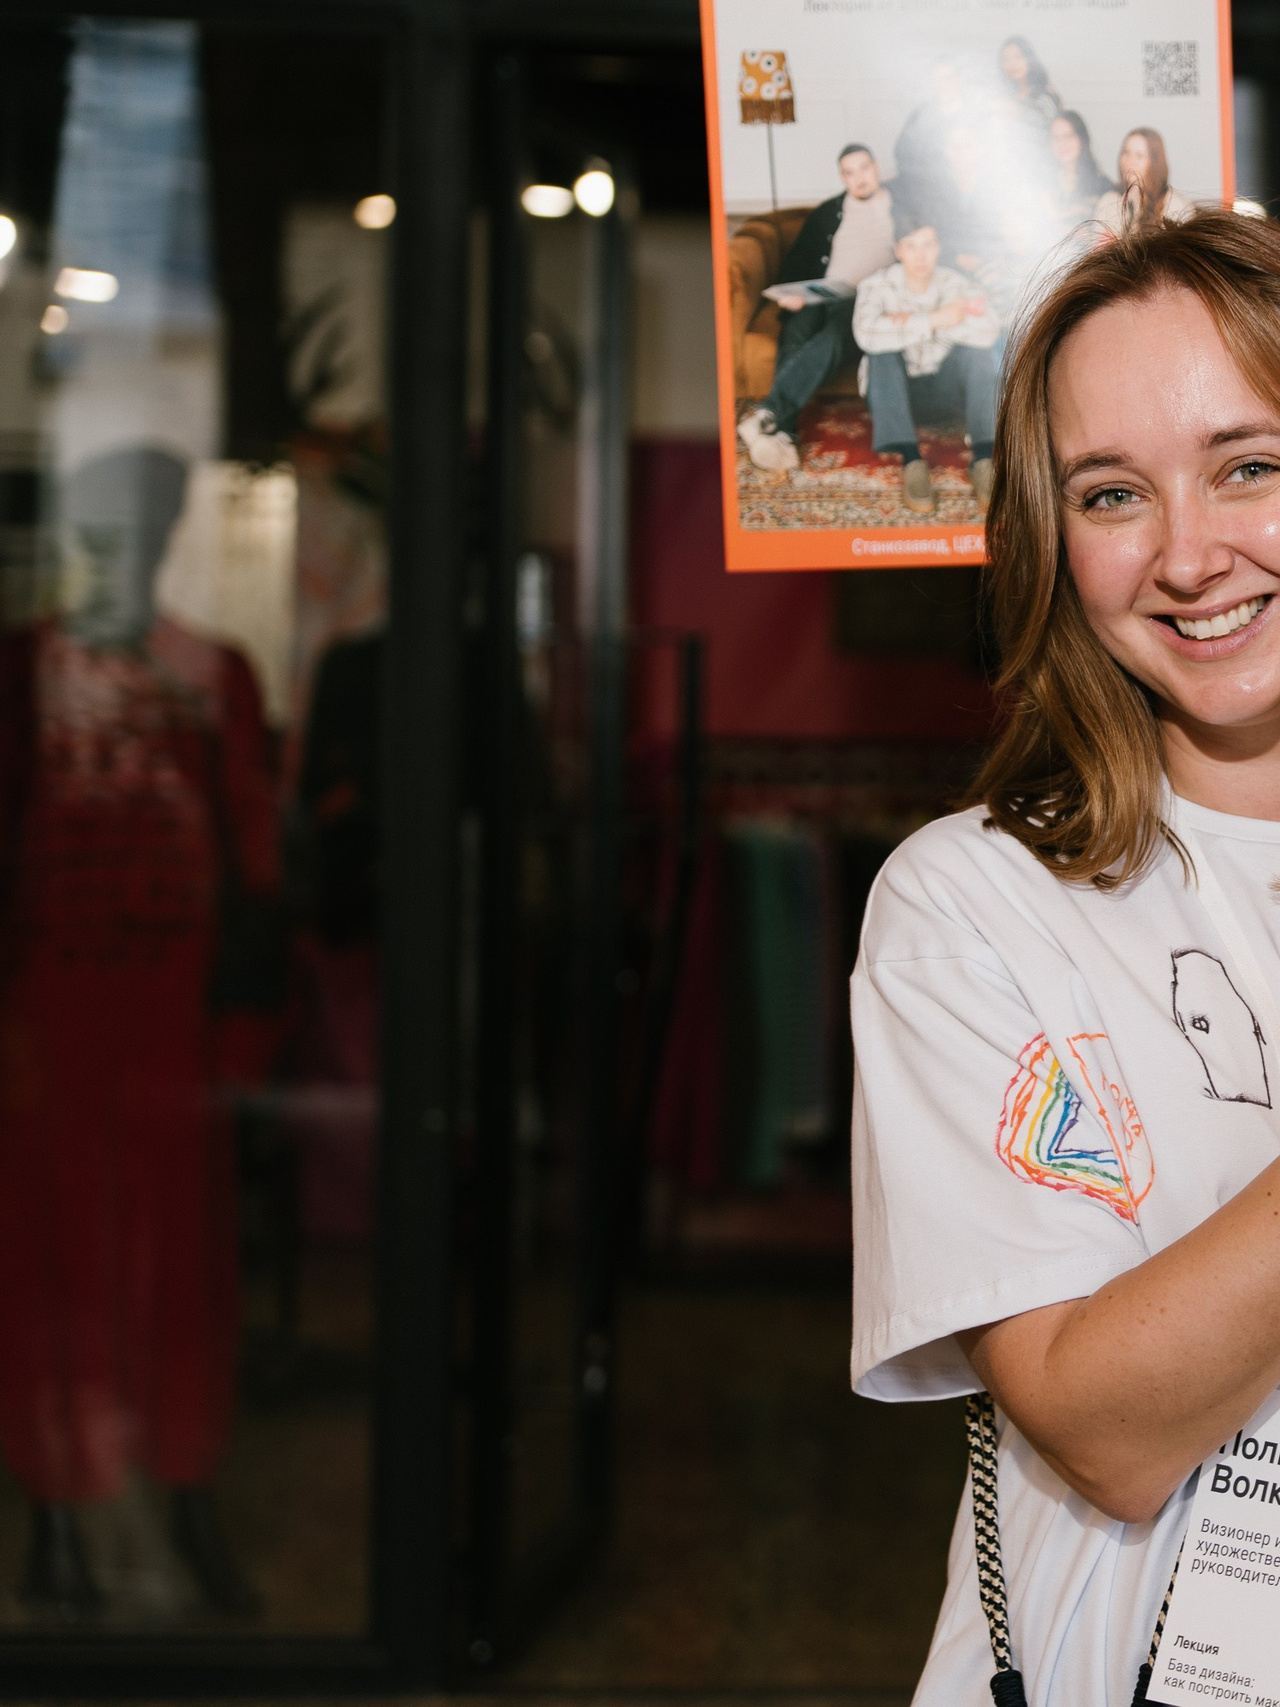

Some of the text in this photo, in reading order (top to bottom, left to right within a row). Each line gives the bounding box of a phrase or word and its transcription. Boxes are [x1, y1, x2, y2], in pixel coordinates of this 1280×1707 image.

[1200, 1518, 1271, 1548] Визионер
[1173, 1635, 1220, 1655] Лекция
[1167, 1658, 1255, 1688] База дизайна:
[1163, 1676, 1185, 1690] как
[1188, 1681, 1252, 1704] построить
